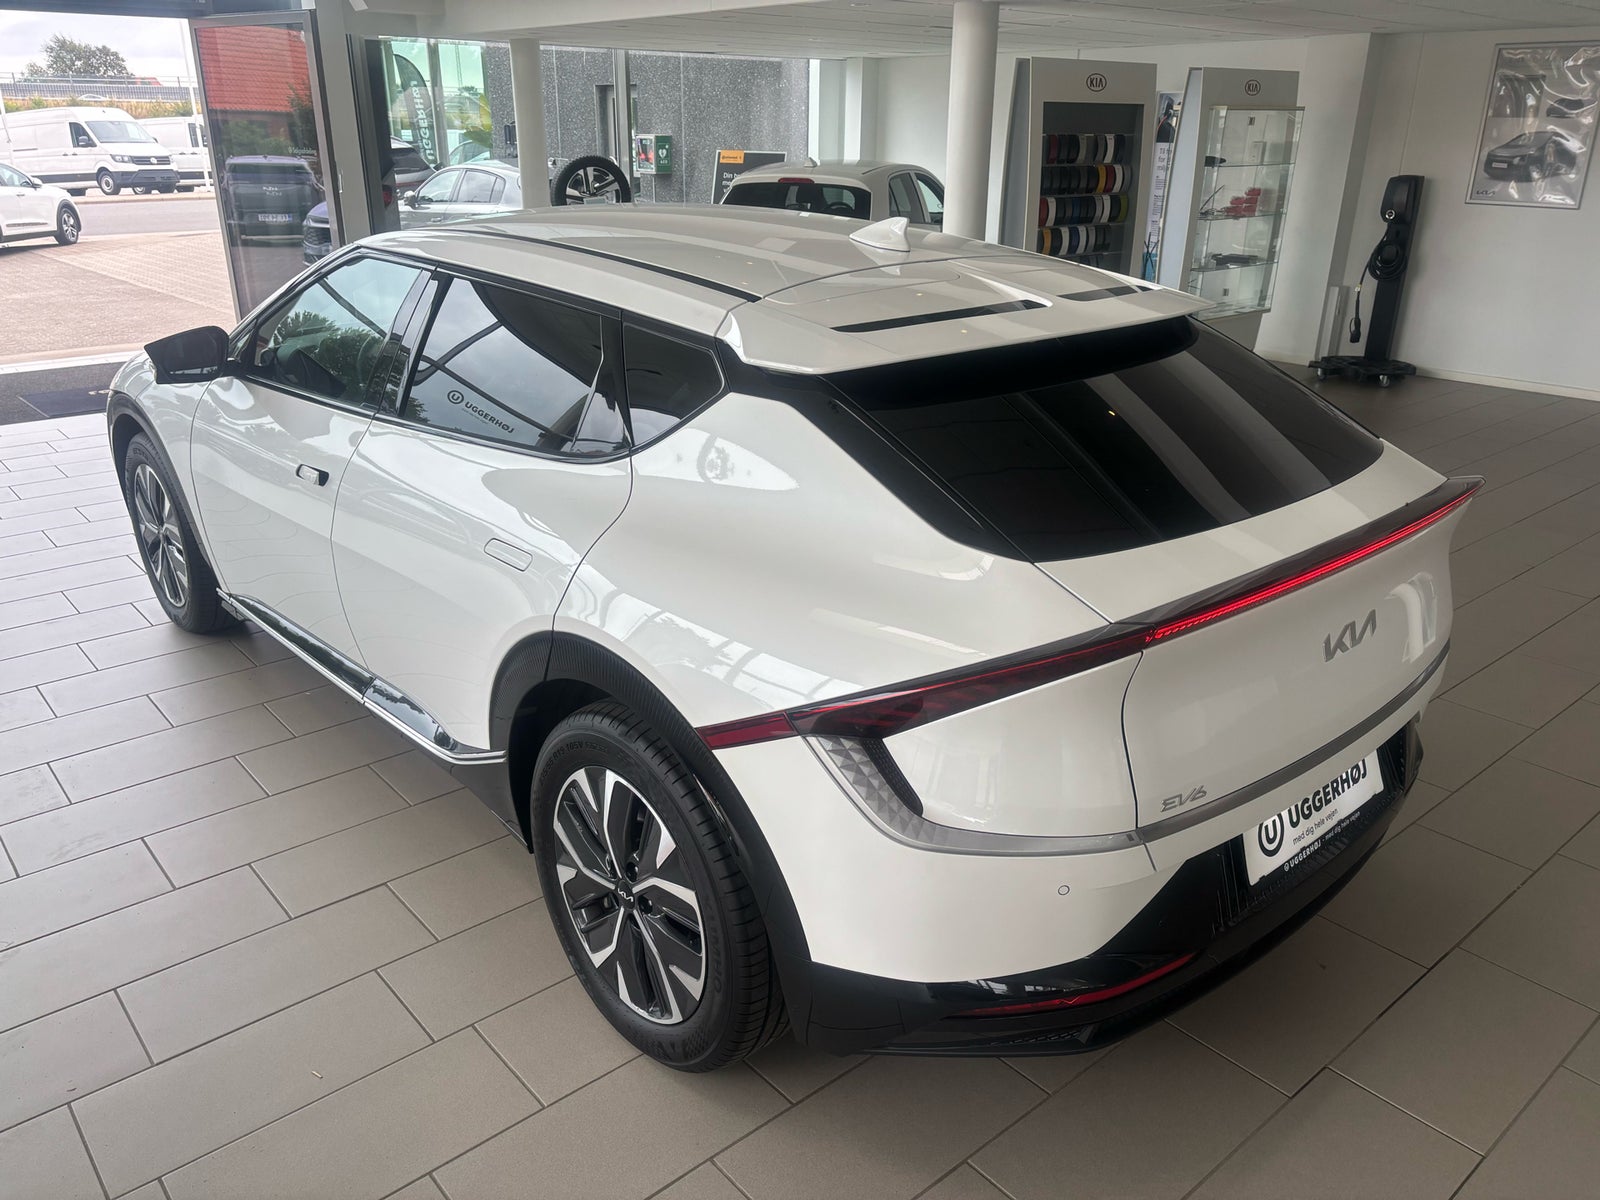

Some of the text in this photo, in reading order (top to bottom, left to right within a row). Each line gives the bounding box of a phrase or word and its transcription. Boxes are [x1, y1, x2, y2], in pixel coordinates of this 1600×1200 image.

[464, 401, 515, 434] UGGERHØJ
[1160, 784, 1208, 812] EV6
[1287, 758, 1368, 829] UGGERHØJ
[1292, 830, 1306, 845] med
[1305, 825, 1315, 836] dig
[1314, 818, 1325, 830] hele
[1289, 839, 1322, 868] UGGERHØJ
